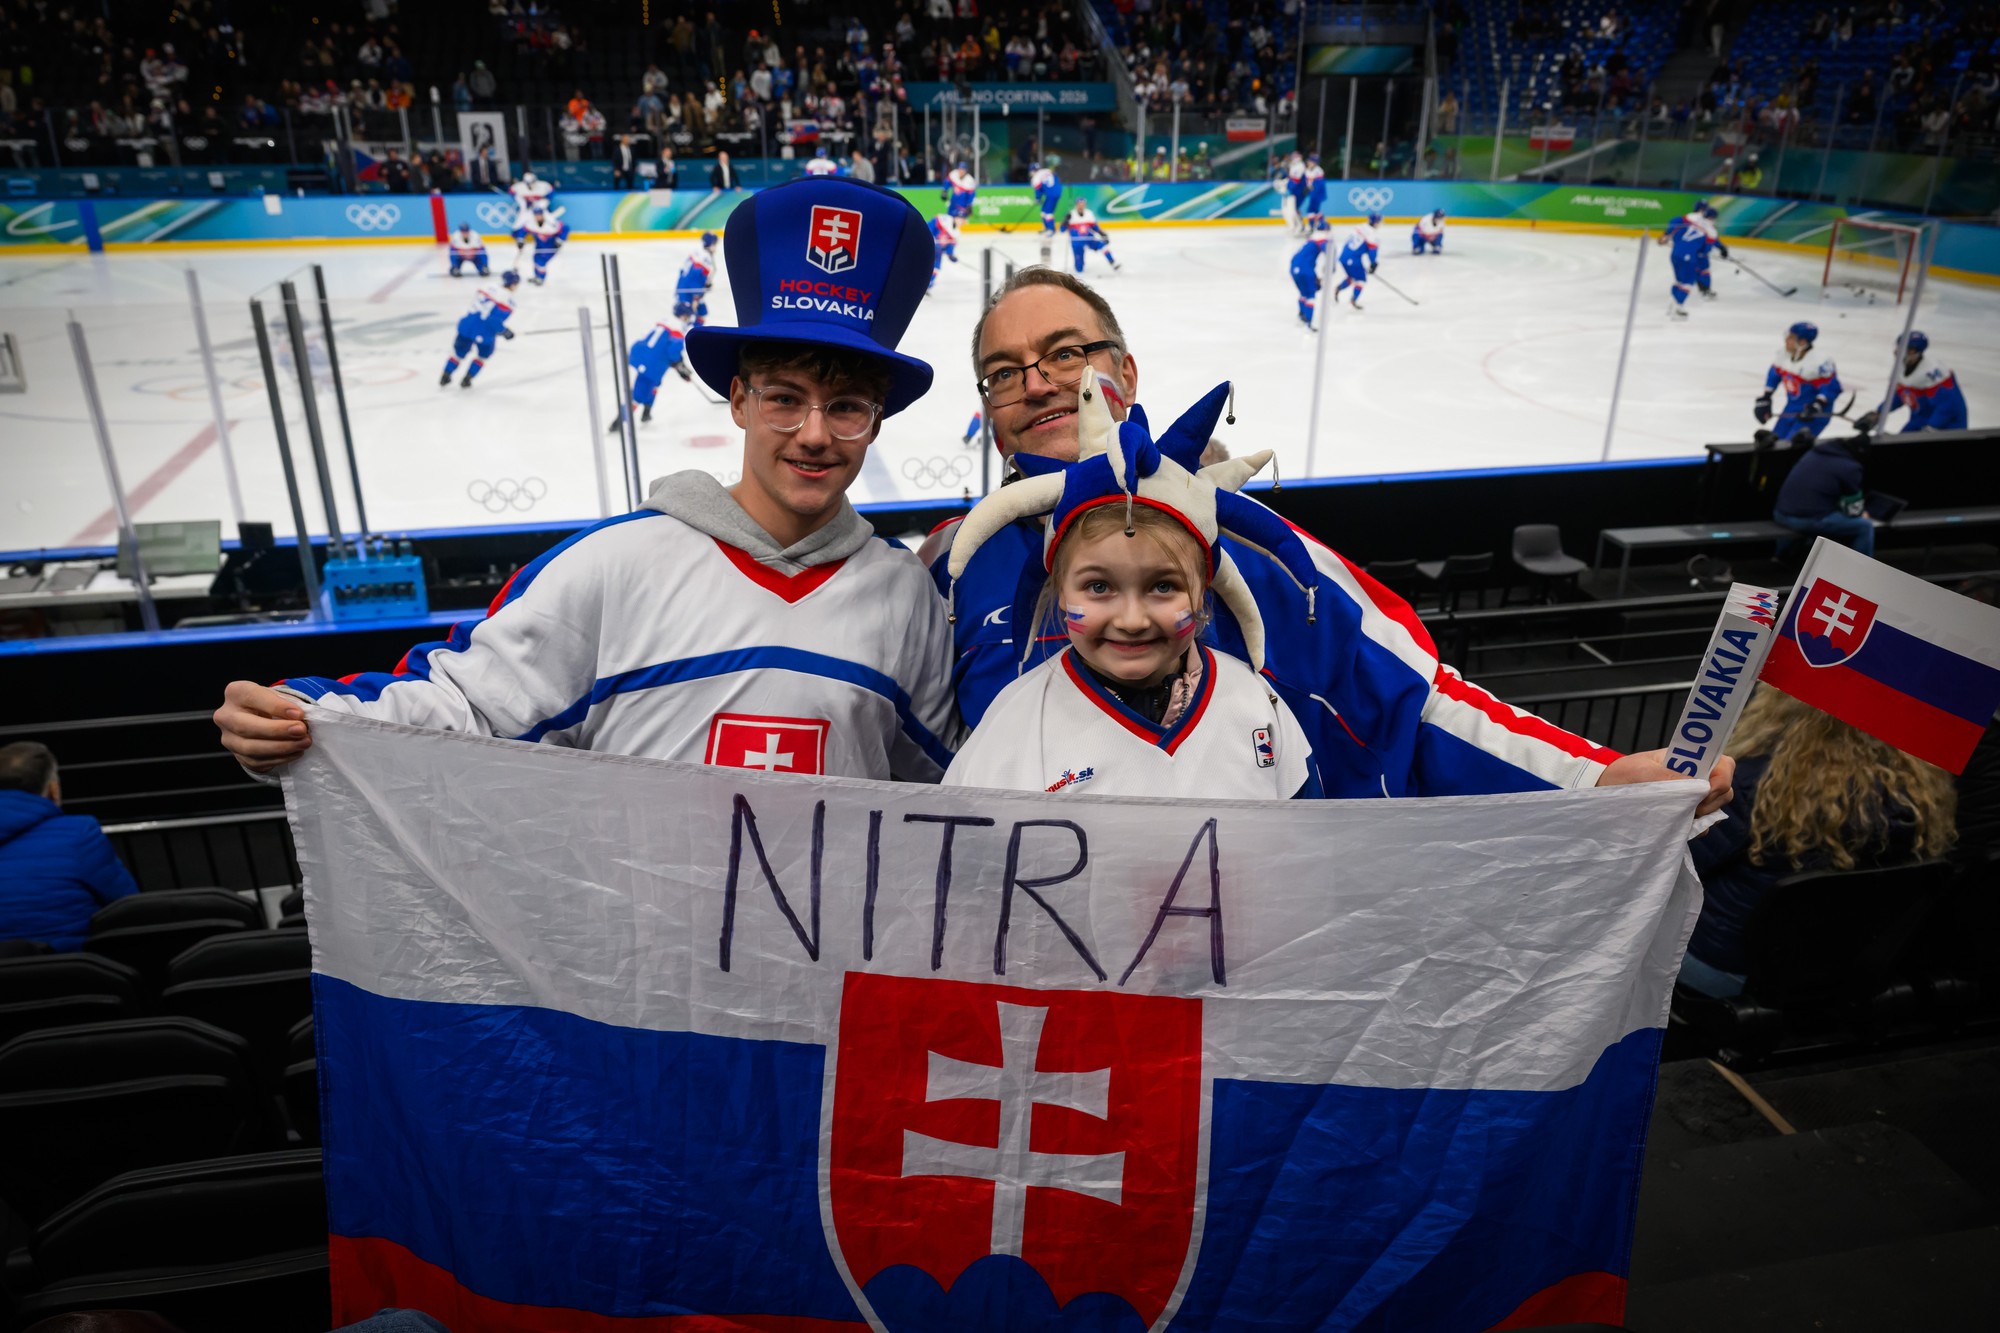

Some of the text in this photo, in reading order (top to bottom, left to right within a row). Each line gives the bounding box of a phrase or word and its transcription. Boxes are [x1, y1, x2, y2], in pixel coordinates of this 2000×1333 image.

[932, 90, 1088, 104] MILNO CORTINA 2026
[780, 279, 872, 304] HOCKEY
[771, 296, 875, 321] SLOVAKIA
[1667, 629, 1759, 777] SLOVAKIA
[719, 793, 1227, 987] NITRA
